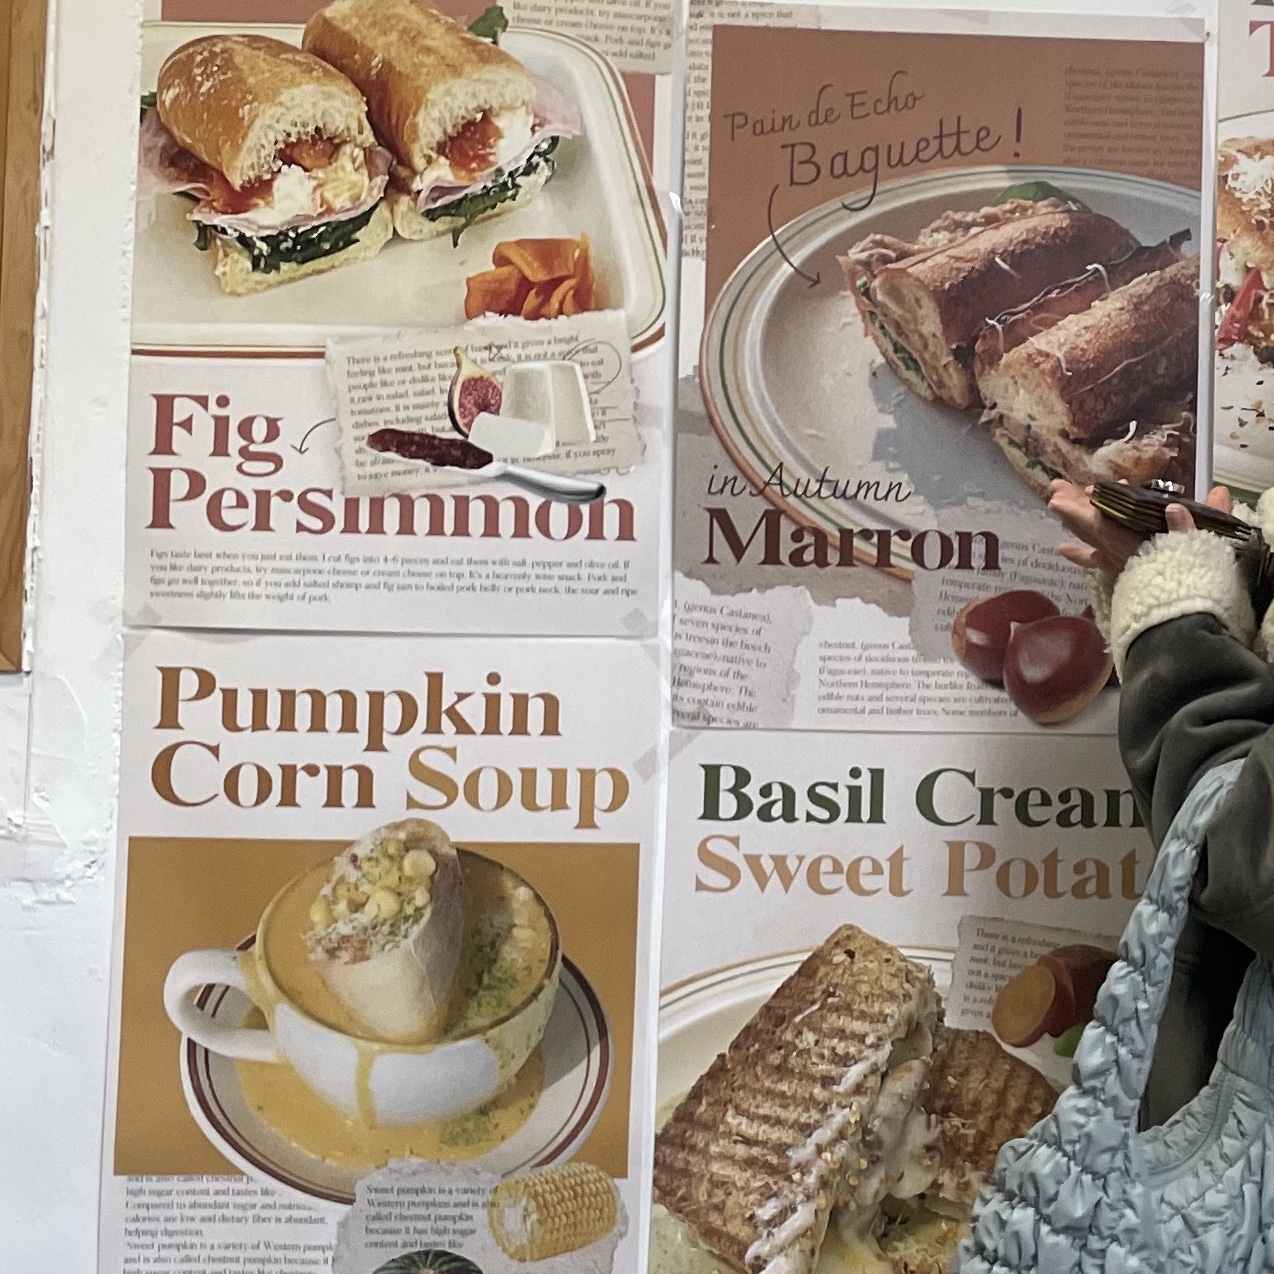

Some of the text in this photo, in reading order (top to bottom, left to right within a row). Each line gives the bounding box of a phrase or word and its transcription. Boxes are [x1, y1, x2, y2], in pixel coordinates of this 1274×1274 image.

[723, 69, 925, 142] Pain de Echo
[148, 394, 284, 477] Fig
[145, 467, 637, 542] Persimmon
[707, 461, 913, 503] in Autumn
[431, 556, 449, 565] and
[566, 559, 583, 568] and
[702, 506, 1000, 571] Marron
[610, 573, 628, 583] and
[154, 666, 562, 752] Pumpkin
[151, 740, 630, 829] Corn Soup
[697, 763, 887, 824] Basil
[694, 834, 1145, 900] Sweet Potat
